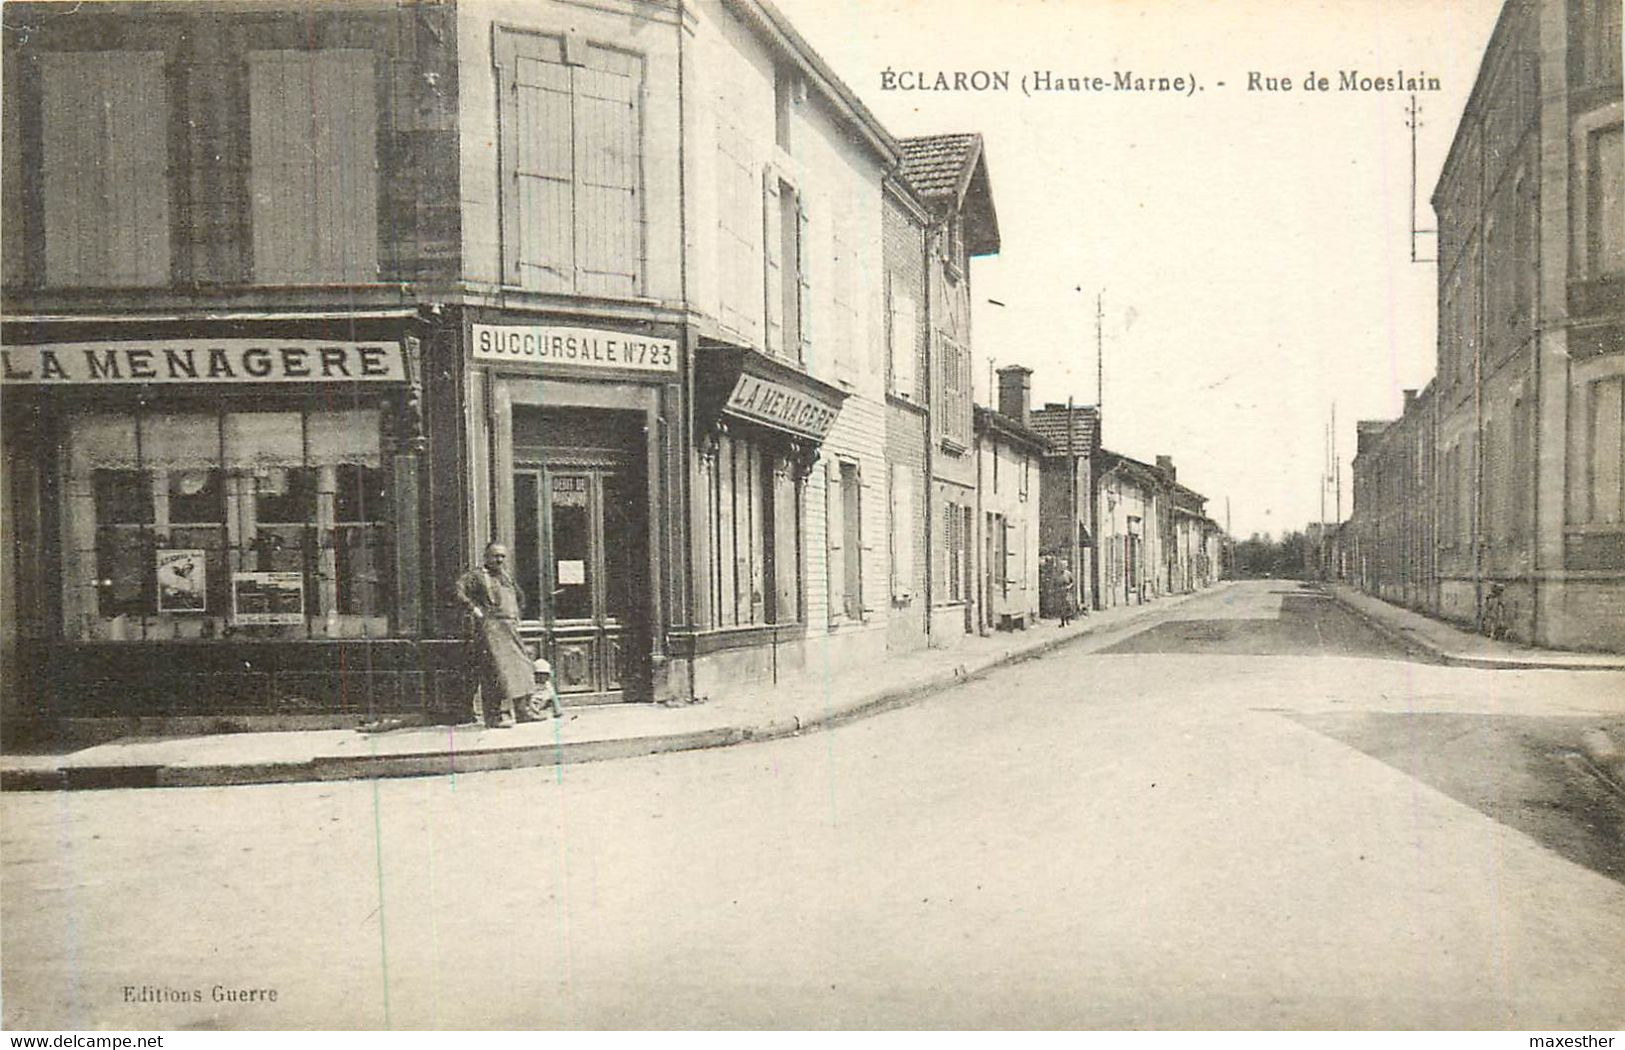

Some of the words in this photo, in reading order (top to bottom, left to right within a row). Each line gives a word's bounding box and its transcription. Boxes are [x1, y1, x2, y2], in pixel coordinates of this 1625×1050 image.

[479, 329, 618, 362] SUCCURSALE
[1, 348, 71, 381] LA
[83, 346, 391, 380] MENAGERE
[733, 378, 760, 409] LA
[757, 387, 835, 432] MENAGERE
